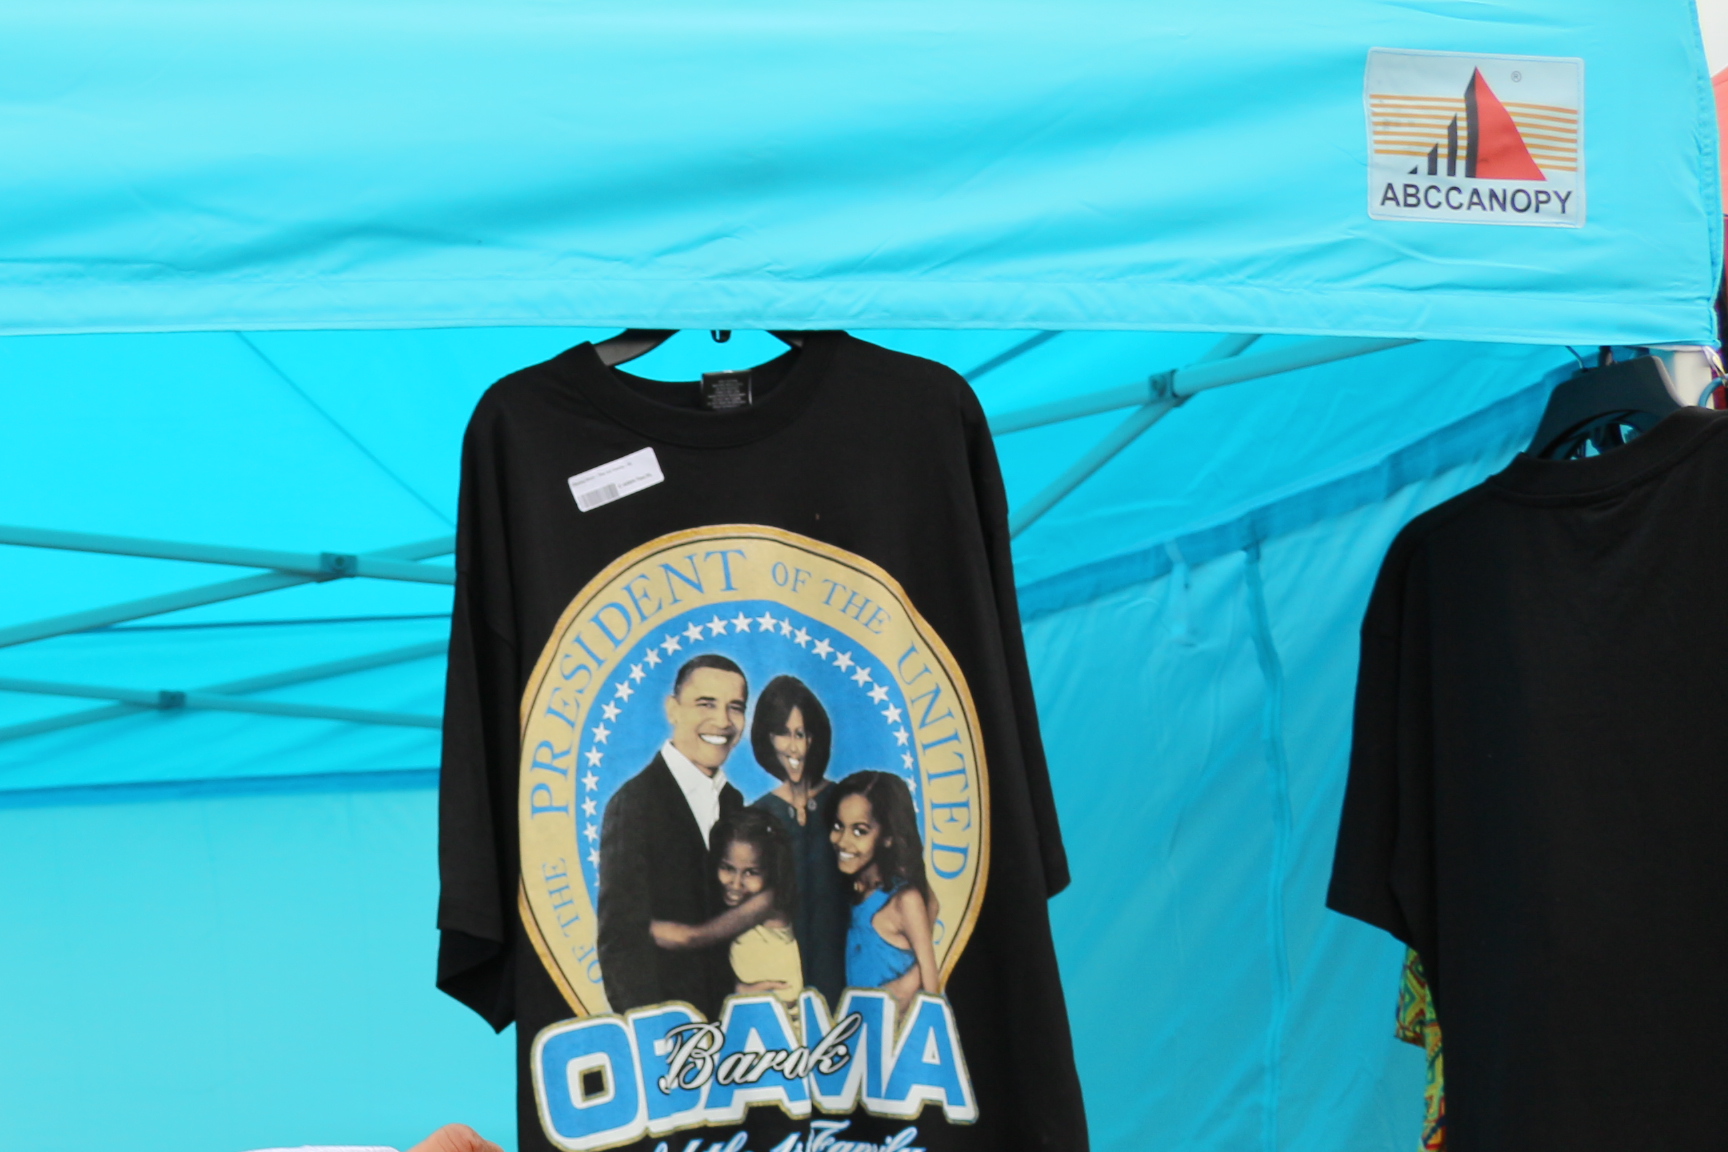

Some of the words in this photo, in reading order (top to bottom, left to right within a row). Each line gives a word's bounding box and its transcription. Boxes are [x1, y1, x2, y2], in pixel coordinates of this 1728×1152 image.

[1380, 182, 1573, 214] ABCCANOPY
[771, 561, 813, 594] OF
[822, 577, 893, 636] THE
[531, 549, 748, 820] PRESIDENT
[895, 644, 971, 881] UNITED
[542, 857, 581, 939] THE
